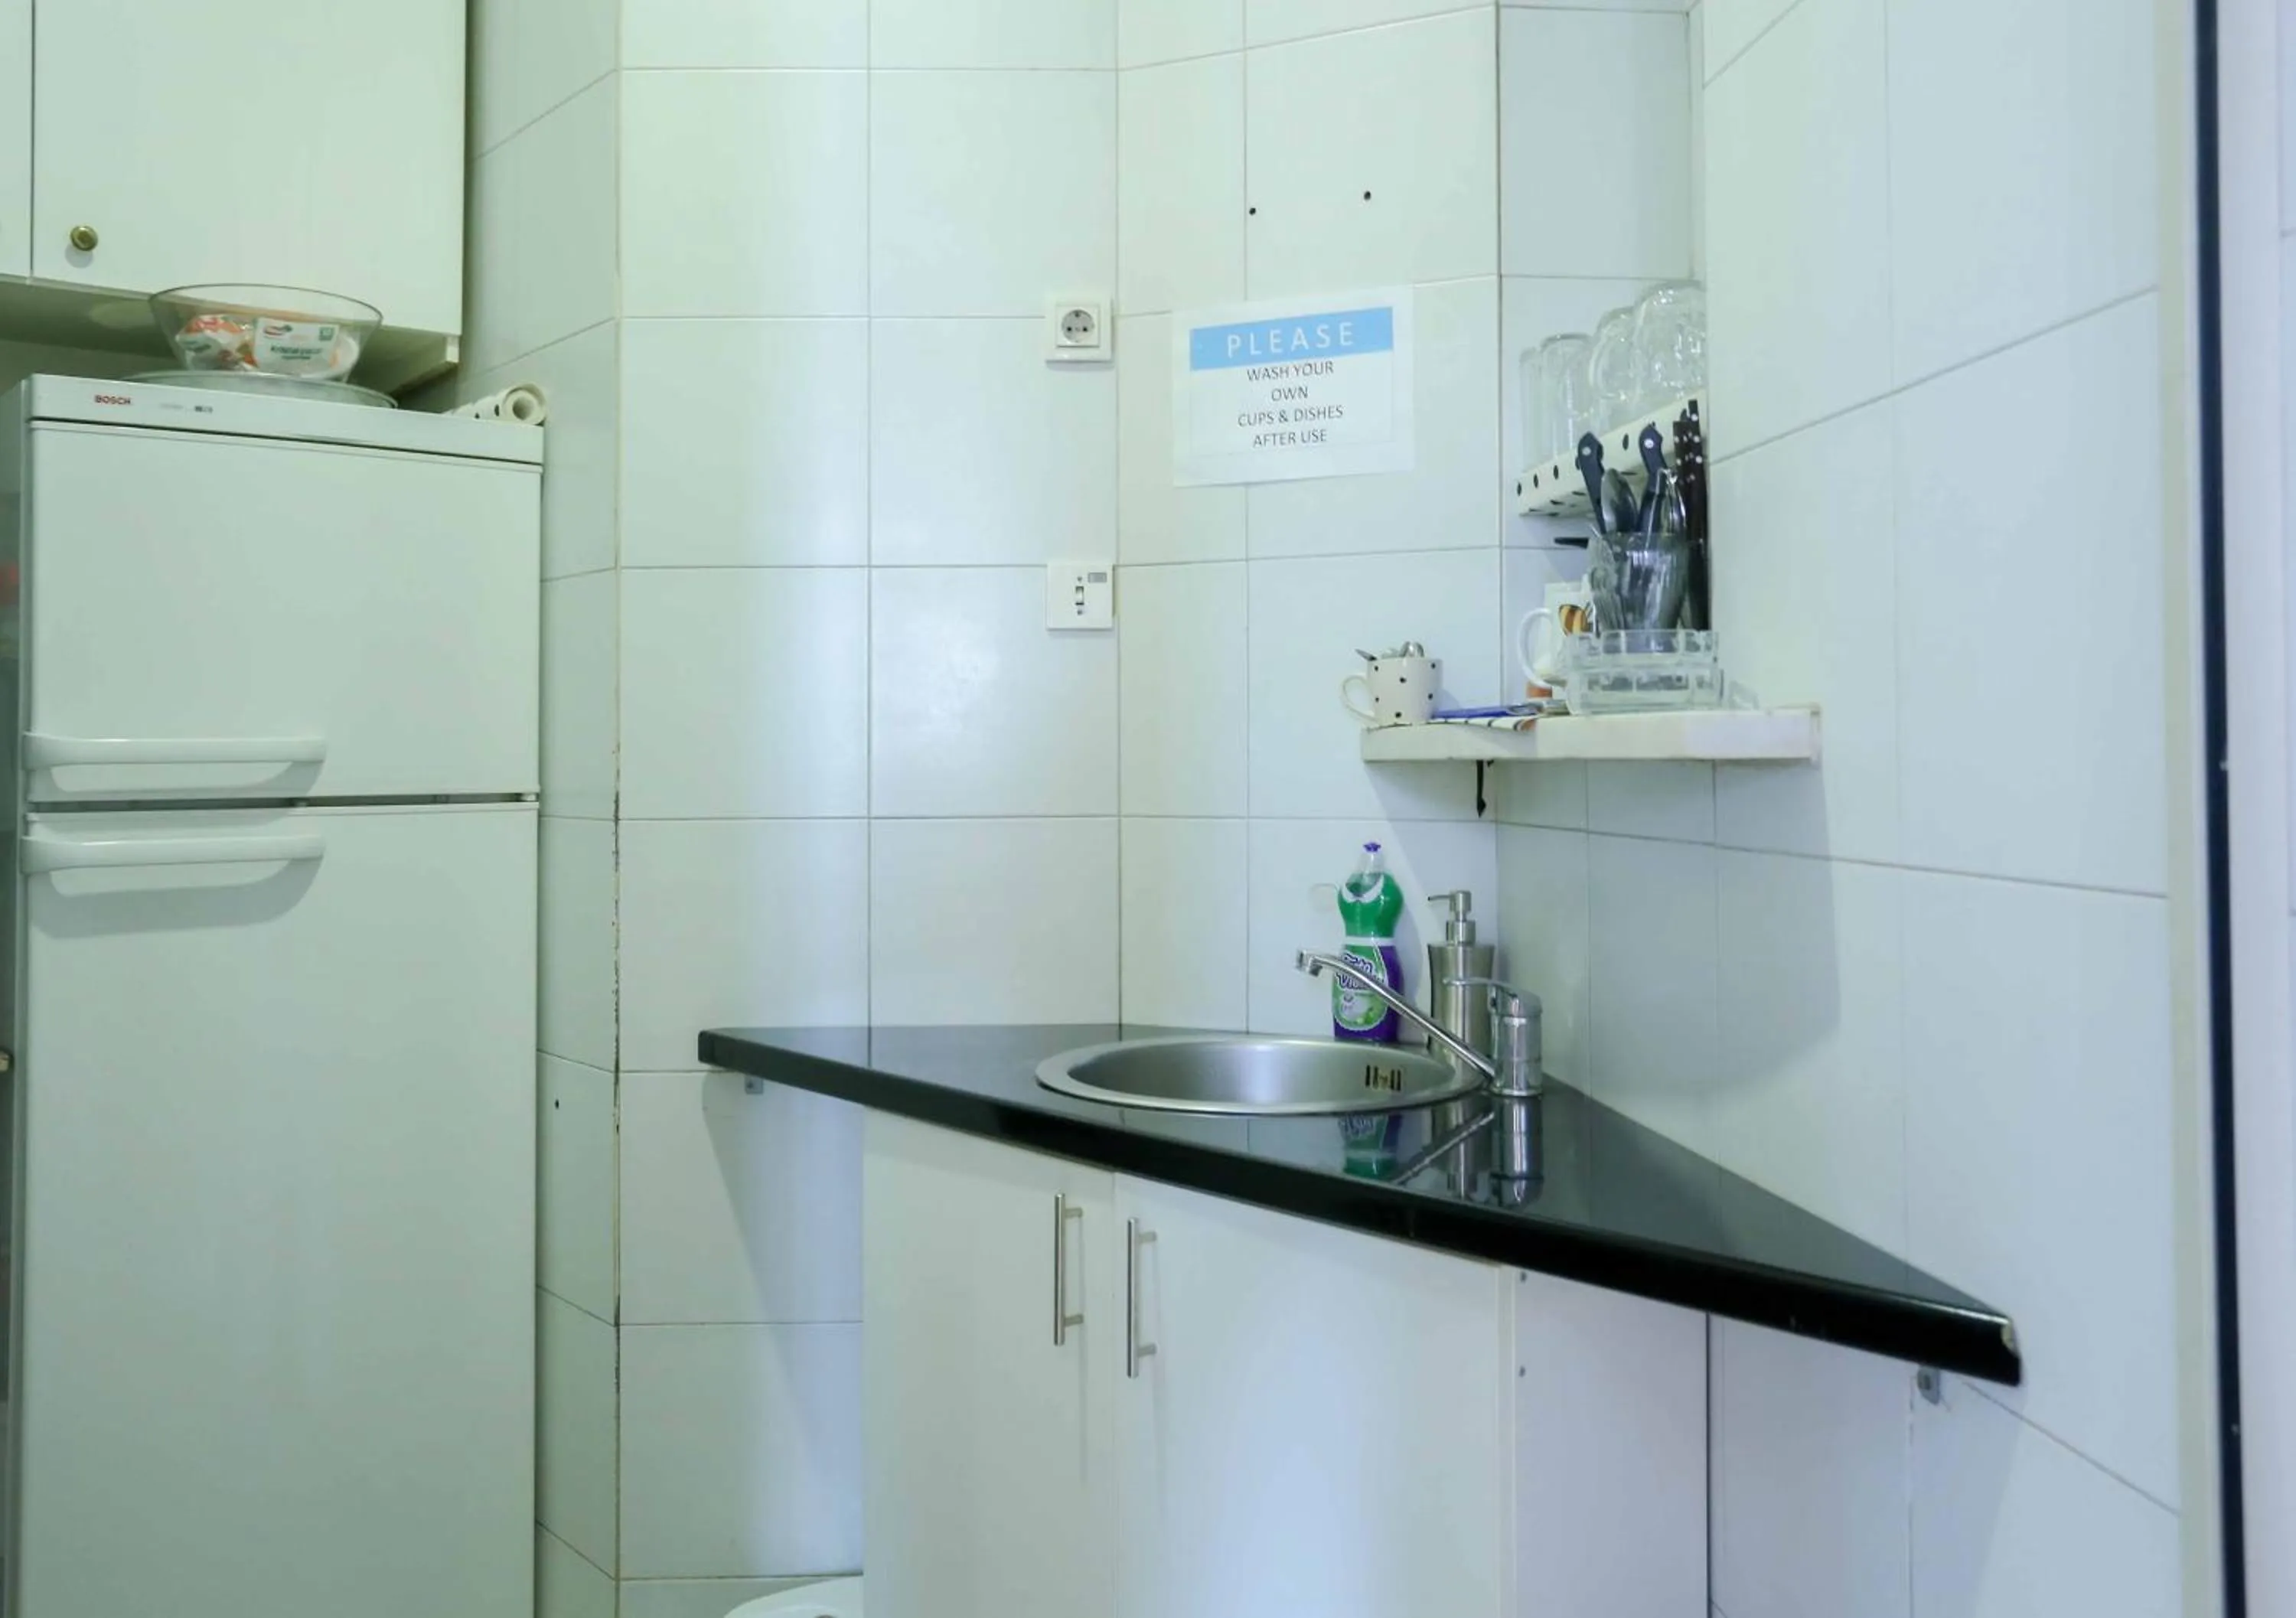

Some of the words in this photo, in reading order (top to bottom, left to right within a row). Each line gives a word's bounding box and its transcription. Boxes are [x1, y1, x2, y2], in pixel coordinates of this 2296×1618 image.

[1226, 321, 1355, 358] PLEASE
[1247, 364, 1290, 381] WASH
[1293, 360, 1335, 378] YOUR
[94, 394, 132, 405] BOSCH
[1270, 386, 1309, 402] OWN
[1238, 410, 1274, 427] CUPS
[1278, 407, 1289, 422] &
[1294, 405, 1344, 422] DISHES
[1253, 432, 1296, 448] AFTER
[1300, 429, 1328, 444] USE
